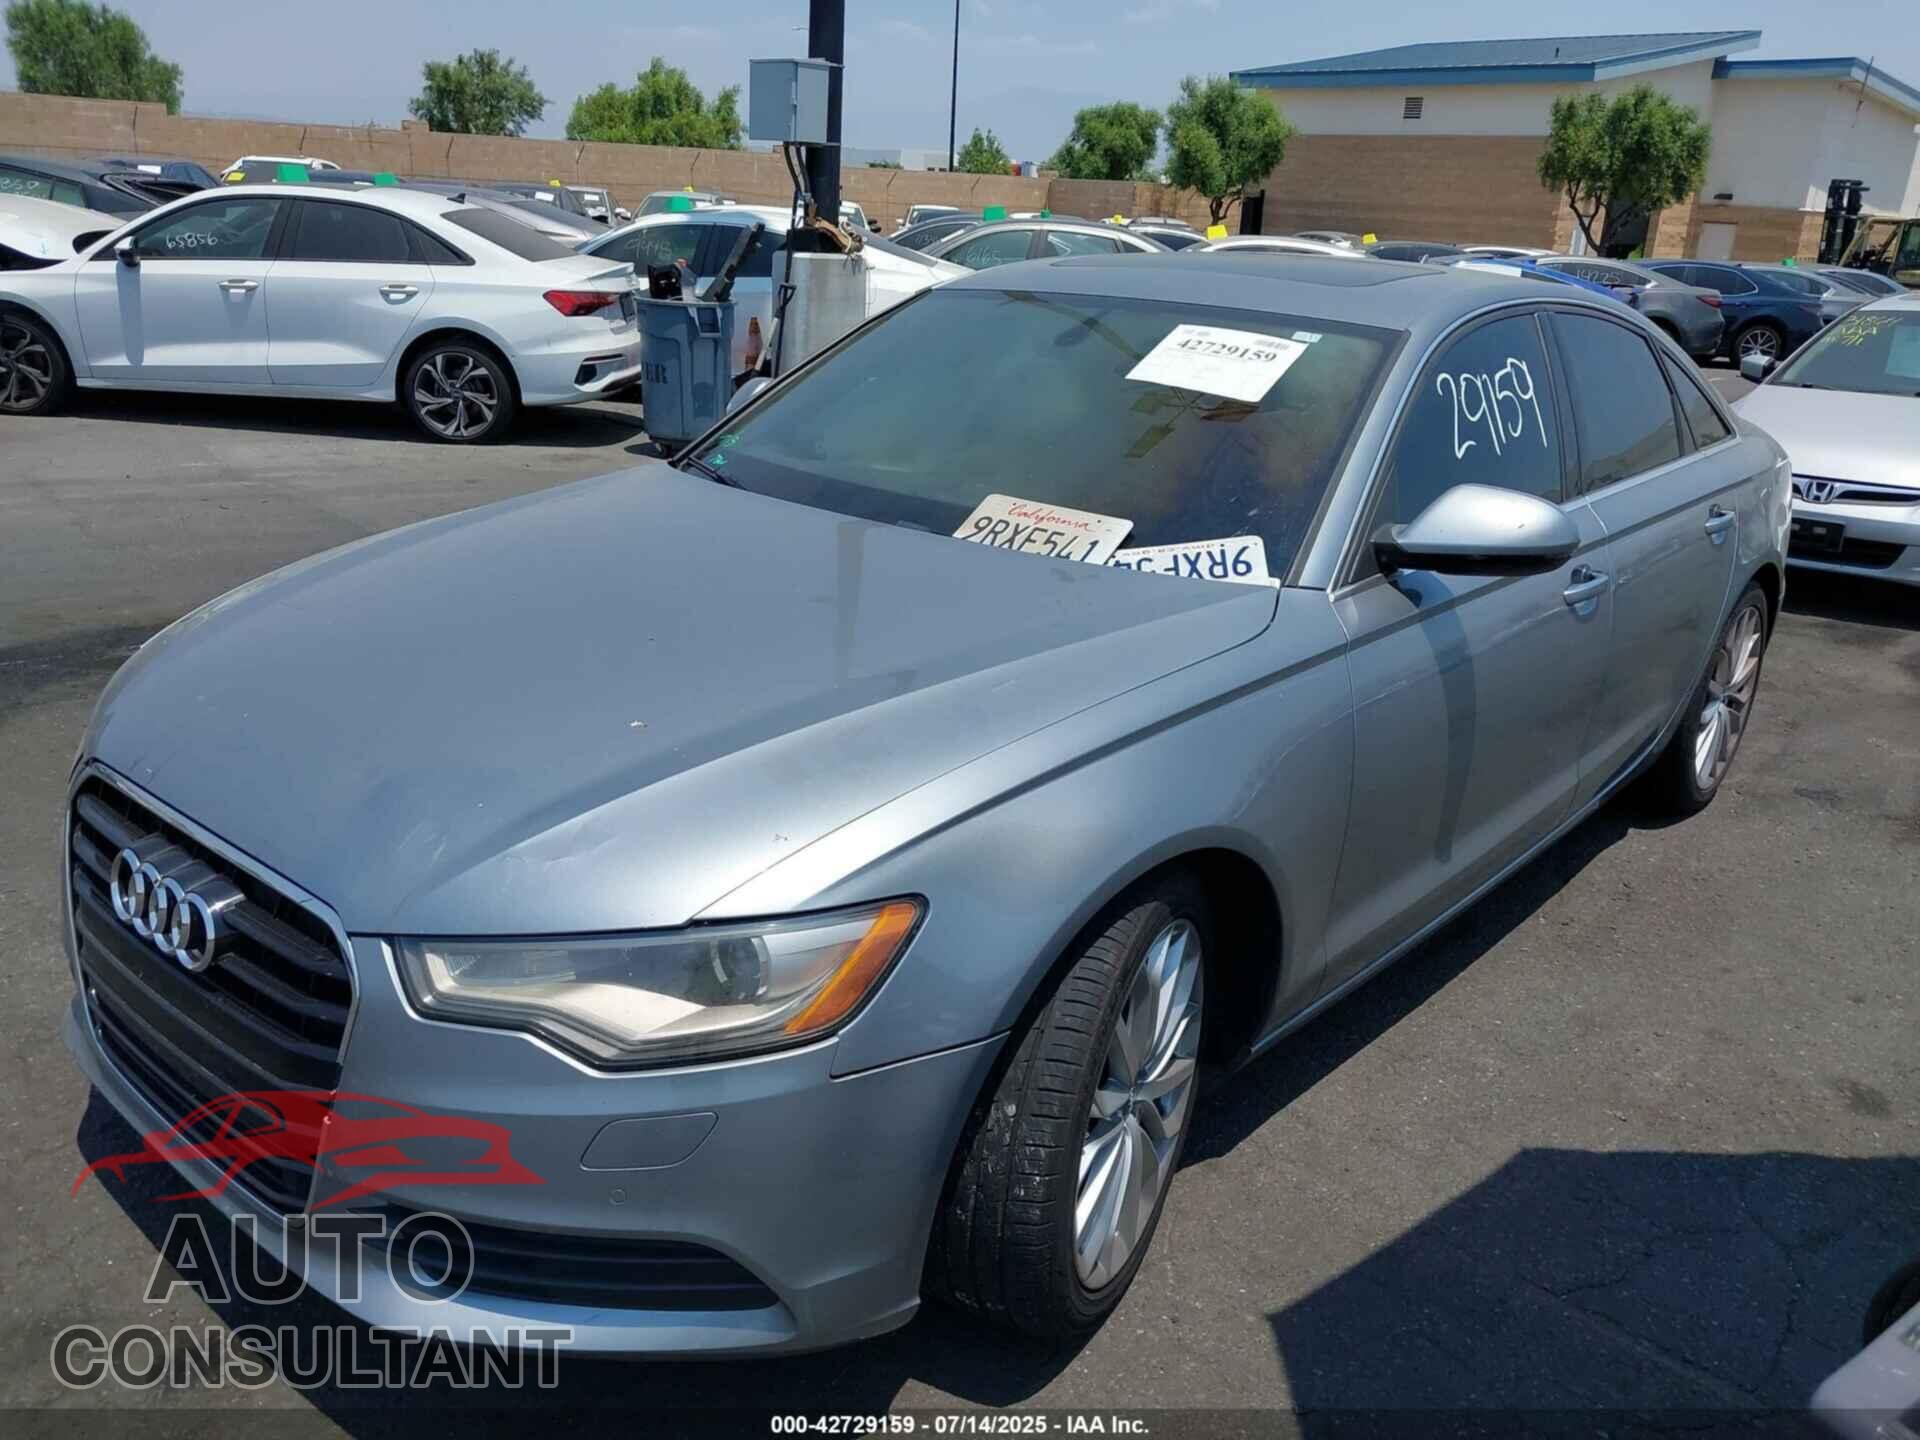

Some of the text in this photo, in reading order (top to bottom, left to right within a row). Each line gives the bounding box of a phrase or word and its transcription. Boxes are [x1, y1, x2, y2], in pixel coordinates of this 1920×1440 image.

[166, 232, 219, 249] 65856
[1176, 338, 1278, 363] 42729159
[1436, 357, 1548, 460] 29159
[1008, 504, 1096, 533] California
[1113, 545, 1253, 579] 9RXF
